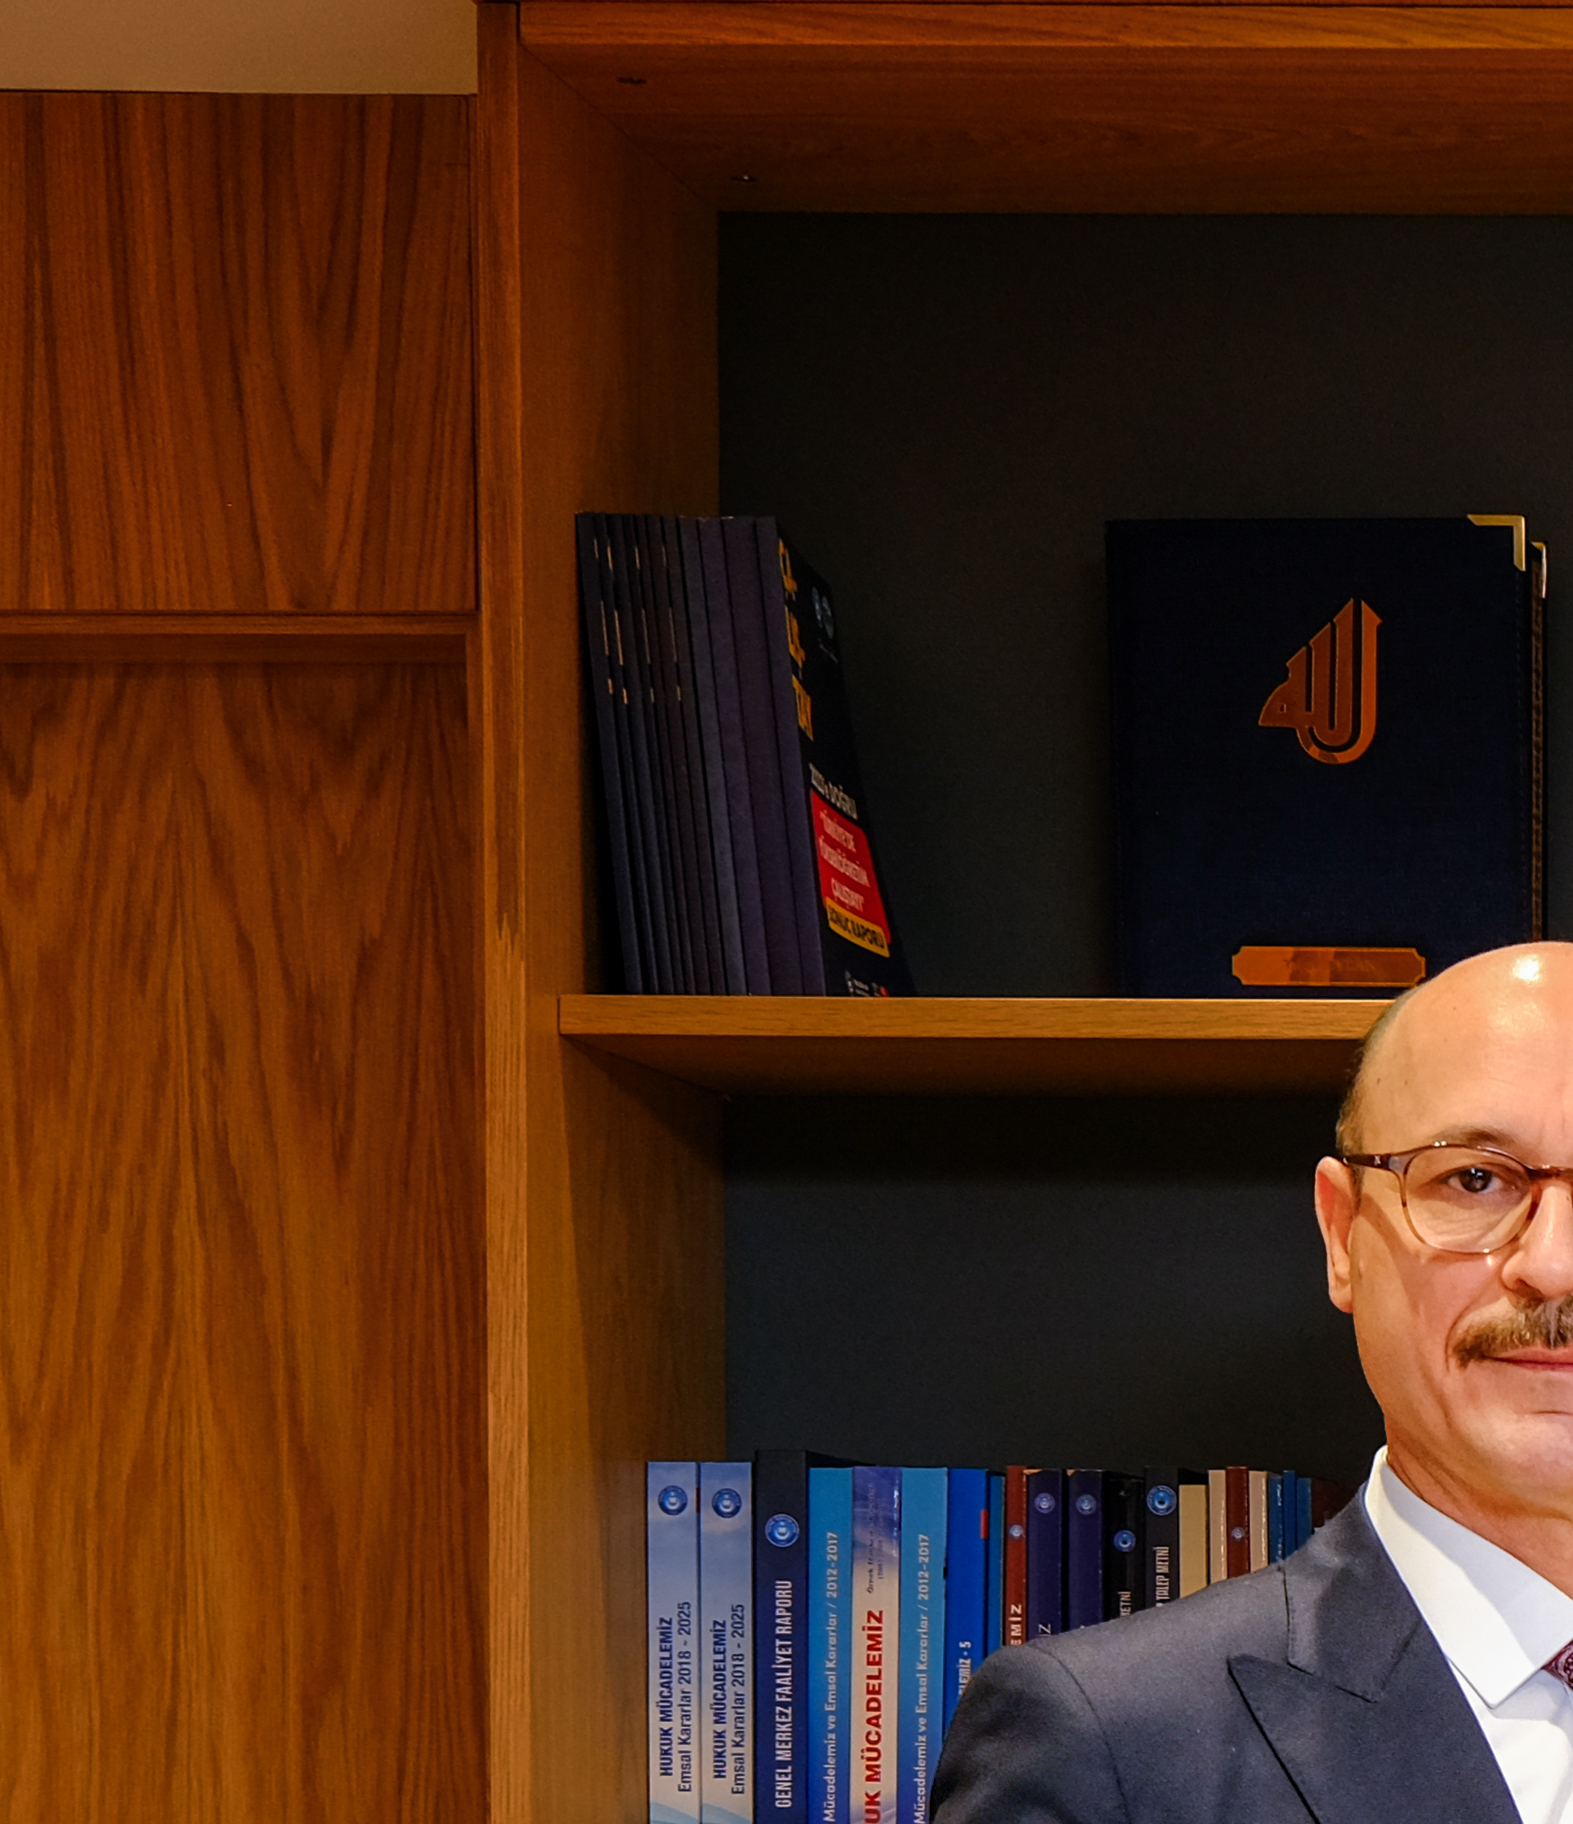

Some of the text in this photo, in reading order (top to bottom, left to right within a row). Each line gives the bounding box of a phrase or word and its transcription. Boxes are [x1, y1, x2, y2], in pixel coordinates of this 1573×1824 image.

[826, 1533, 838, 1598] 2012-2017
[1153, 1547, 1170, 1600] TALEP METNİ
[677, 1602, 691, 1636] 2025
[826, 1613, 837, 1668] Kararlar
[677, 1651, 691, 1684] 2018
[772, 1581, 792, 1808] GENEL MERKEZ FAALİYET RAPORU
[825, 1672, 836, 1711] Emsal
[656, 1618, 673, 1776] HUKUK MÜCADELEMİZ
[677, 1689, 692, 1745] Kararlar
[826, 1715, 836, 1731] ve
[861, 1610, 883, 1782] MÜCADELEMİZ
[677, 1751, 692, 1792] Emsal
[824, 1734, 836, 1822] Mücadelemiz
